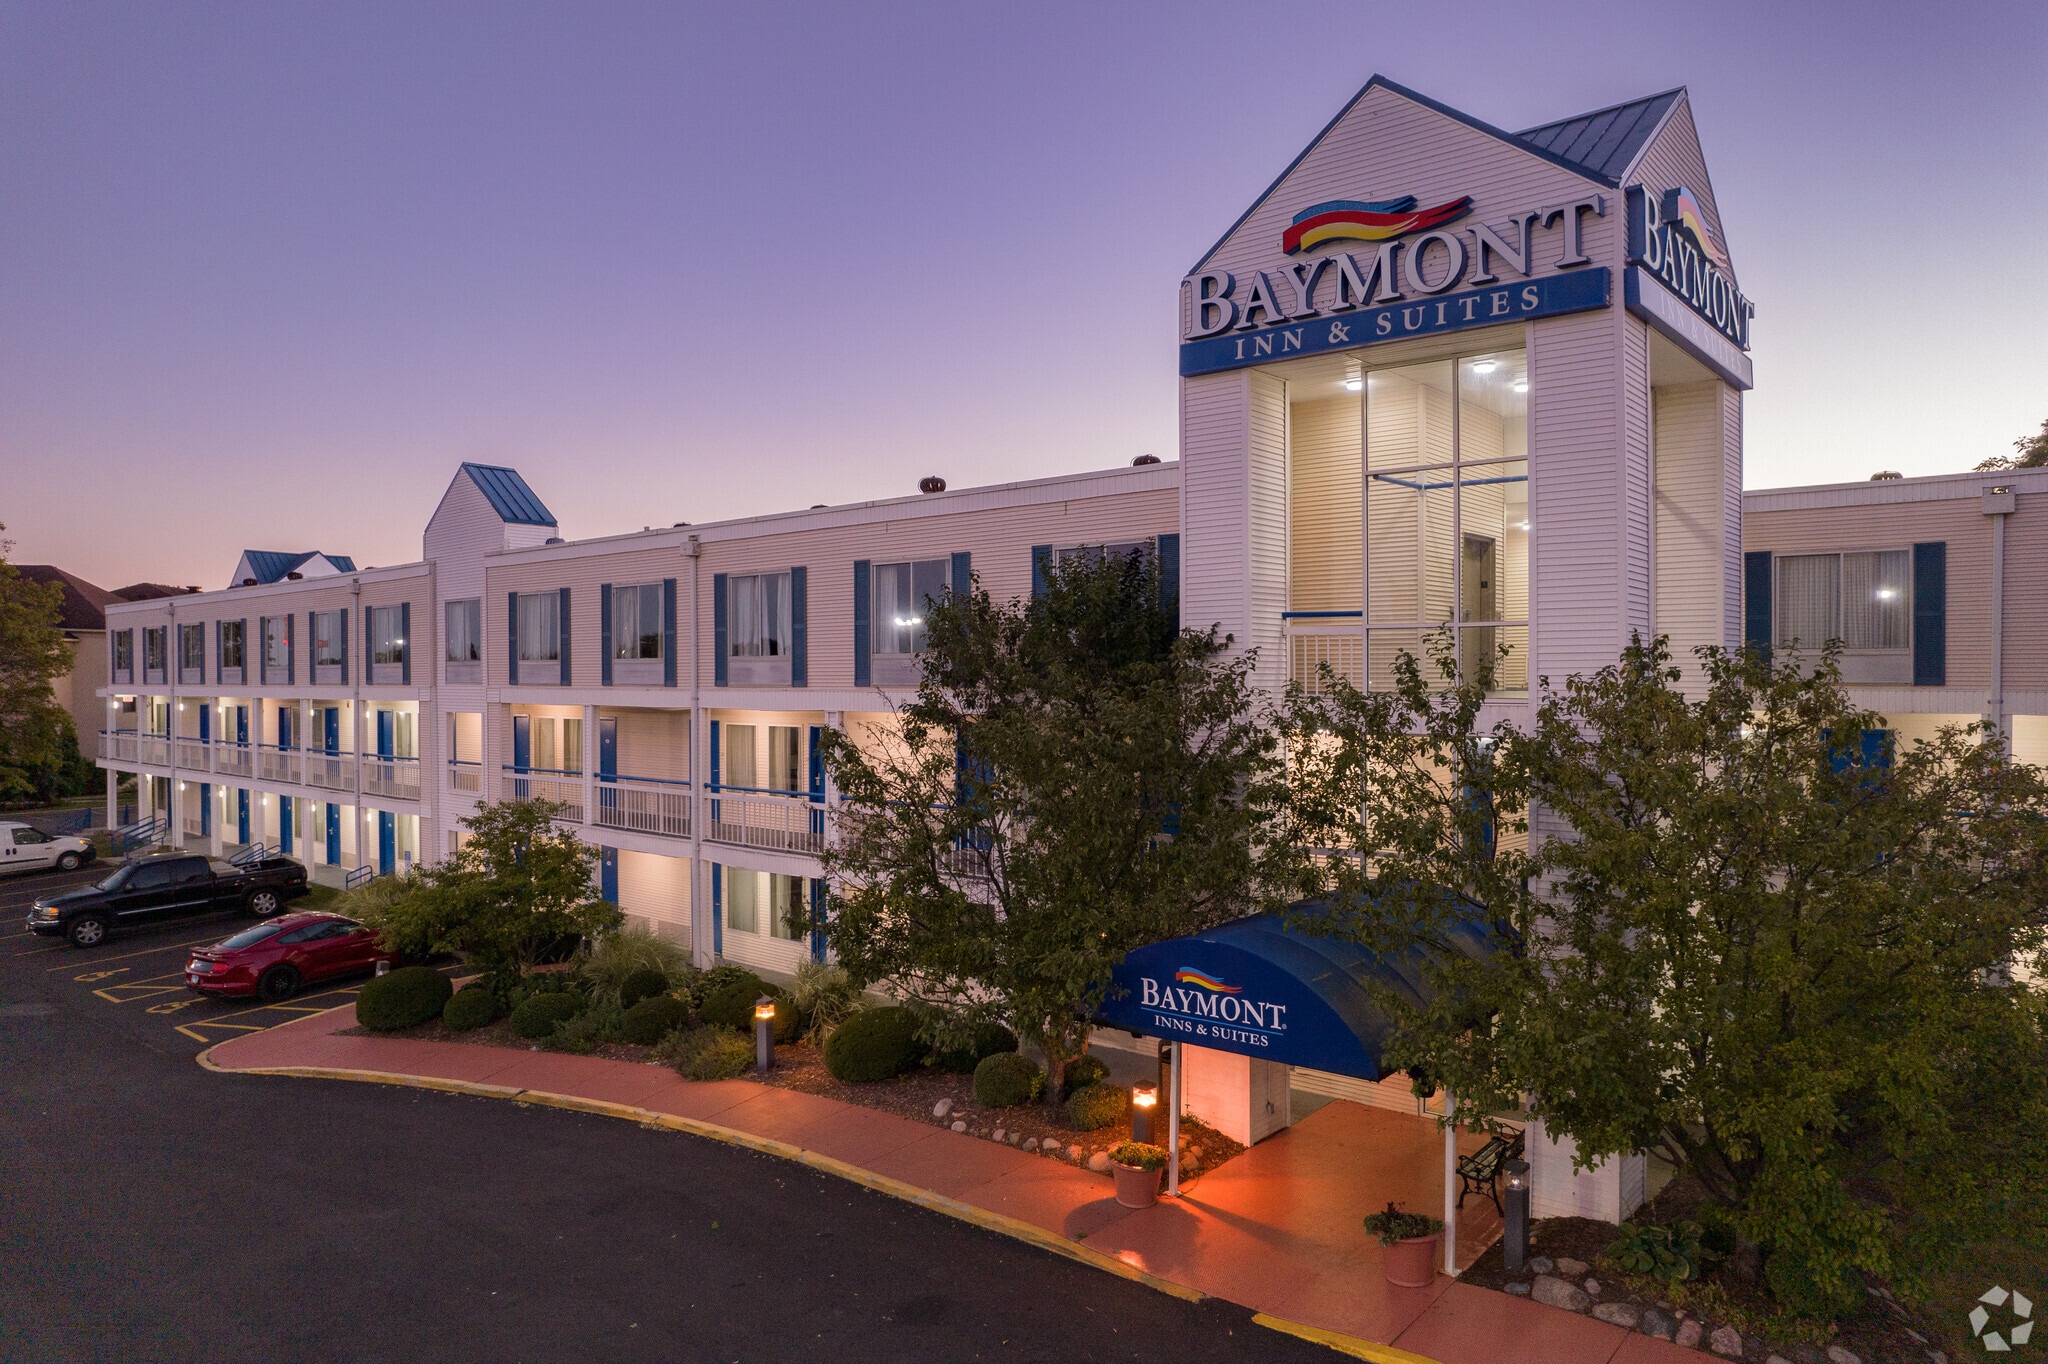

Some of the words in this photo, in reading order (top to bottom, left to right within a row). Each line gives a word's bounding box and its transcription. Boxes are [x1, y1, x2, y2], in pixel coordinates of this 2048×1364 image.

[1183, 193, 1605, 341] BAYMONT
[1638, 183, 1754, 351] BAYMONT
[1235, 328, 1304, 360] INN
[1328, 321, 1351, 344] &
[1376, 285, 1539, 336] SUITES
[1660, 291, 1684, 331] INN
[1704, 327, 1742, 374] SUITES
[1154, 1014, 1193, 1033] INNS
[1196, 1023, 1208, 1036] &
[1211, 1025, 1269, 1047] SUITES
